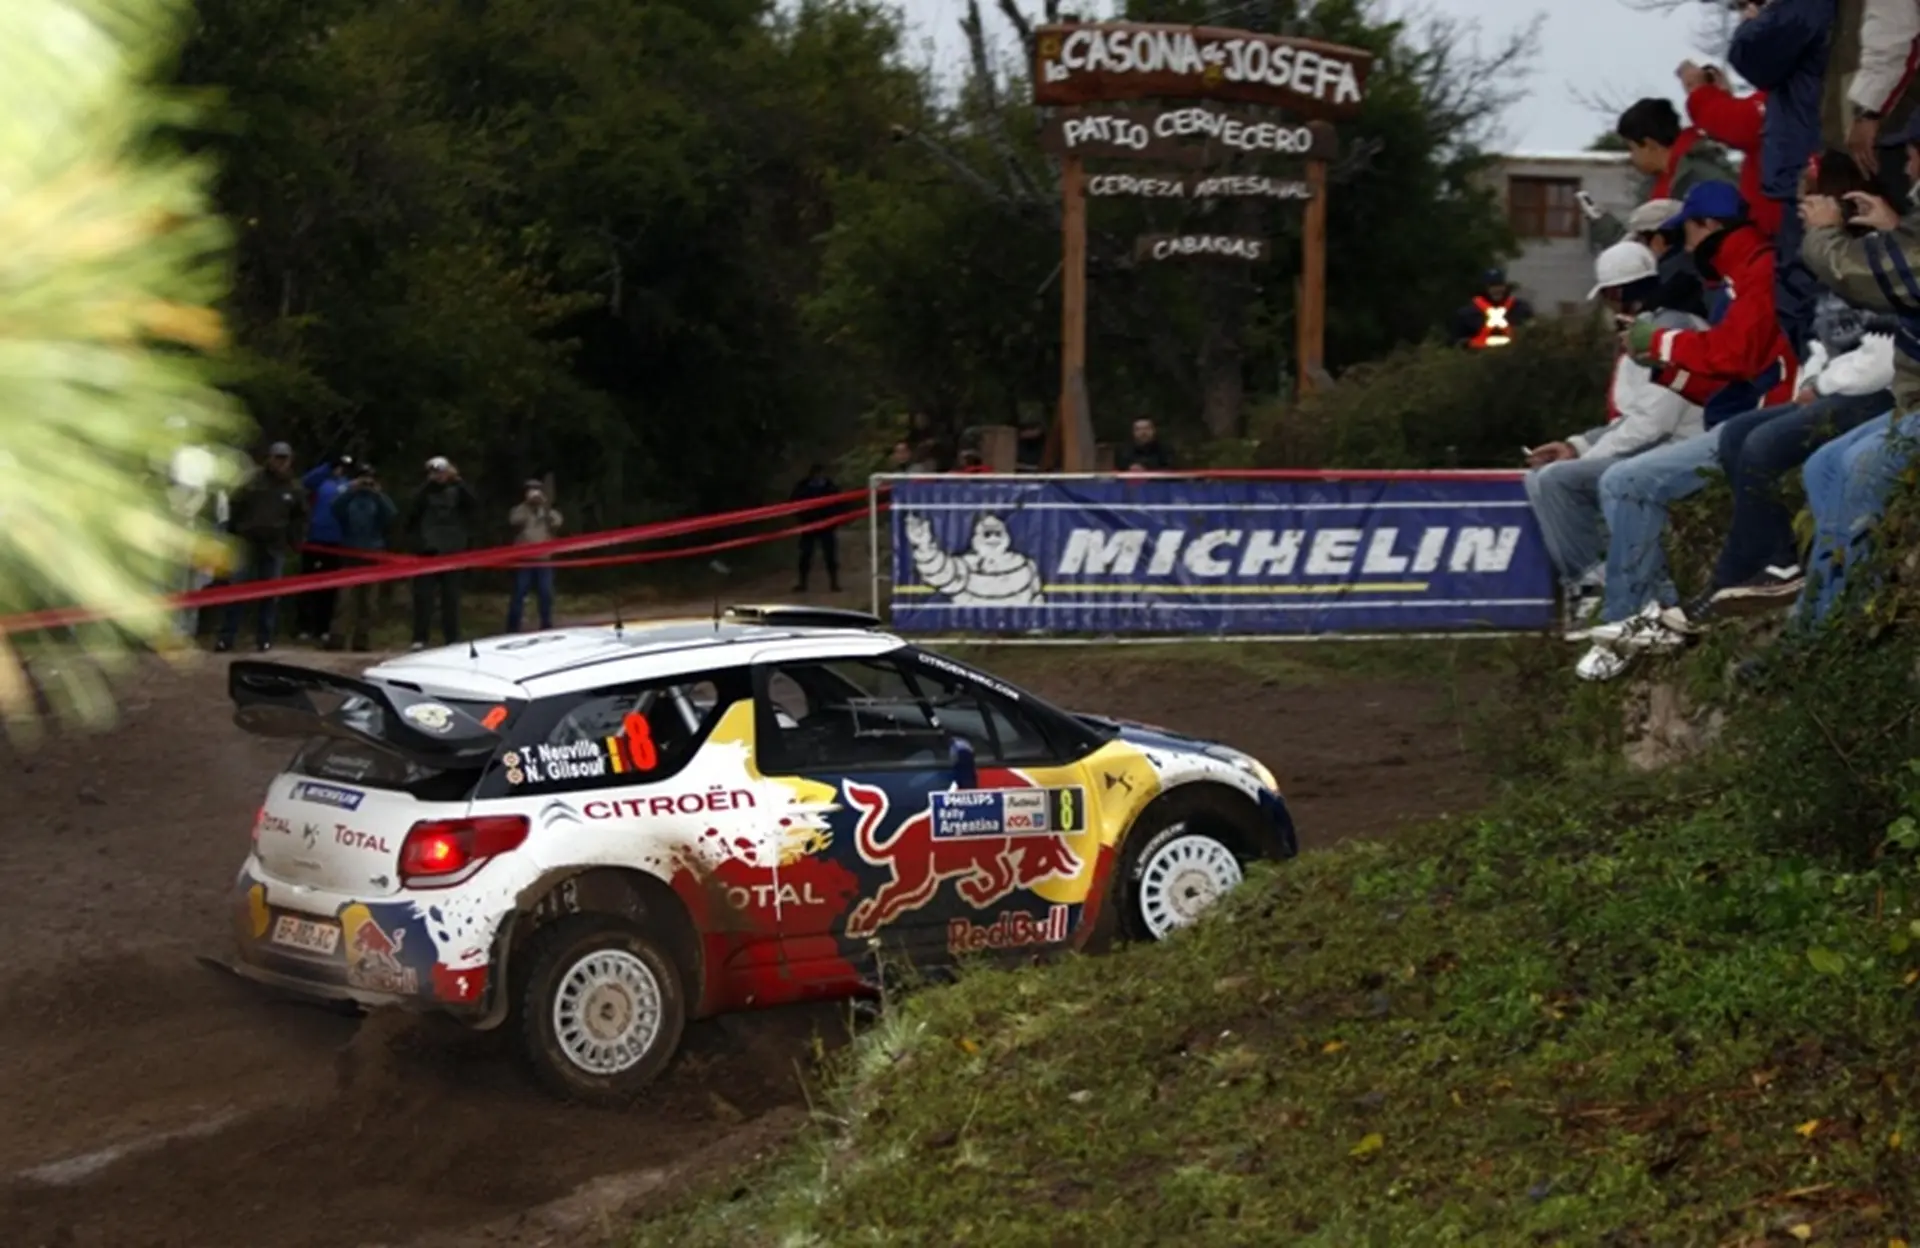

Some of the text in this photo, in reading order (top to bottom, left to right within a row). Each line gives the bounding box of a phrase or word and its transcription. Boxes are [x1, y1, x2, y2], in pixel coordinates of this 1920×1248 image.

[1061, 30, 1204, 75] CASONA
[1223, 40, 1362, 104] JOSEFA
[1063, 108, 1313, 152] PATIO CERVECERO
[1089, 174, 1184, 198] CERVEZA
[1058, 526, 1521, 576] MICHELIN
[520, 739, 599, 764] T. Neuville
[623, 711, 657, 770] 8
[524, 756, 605, 783] N. Gilsoul
[939, 808, 965, 821] Rally
[1060, 788, 1073, 831] 8
[334, 823, 391, 854] TOTAL
[939, 818, 1000, 836] Argentina
